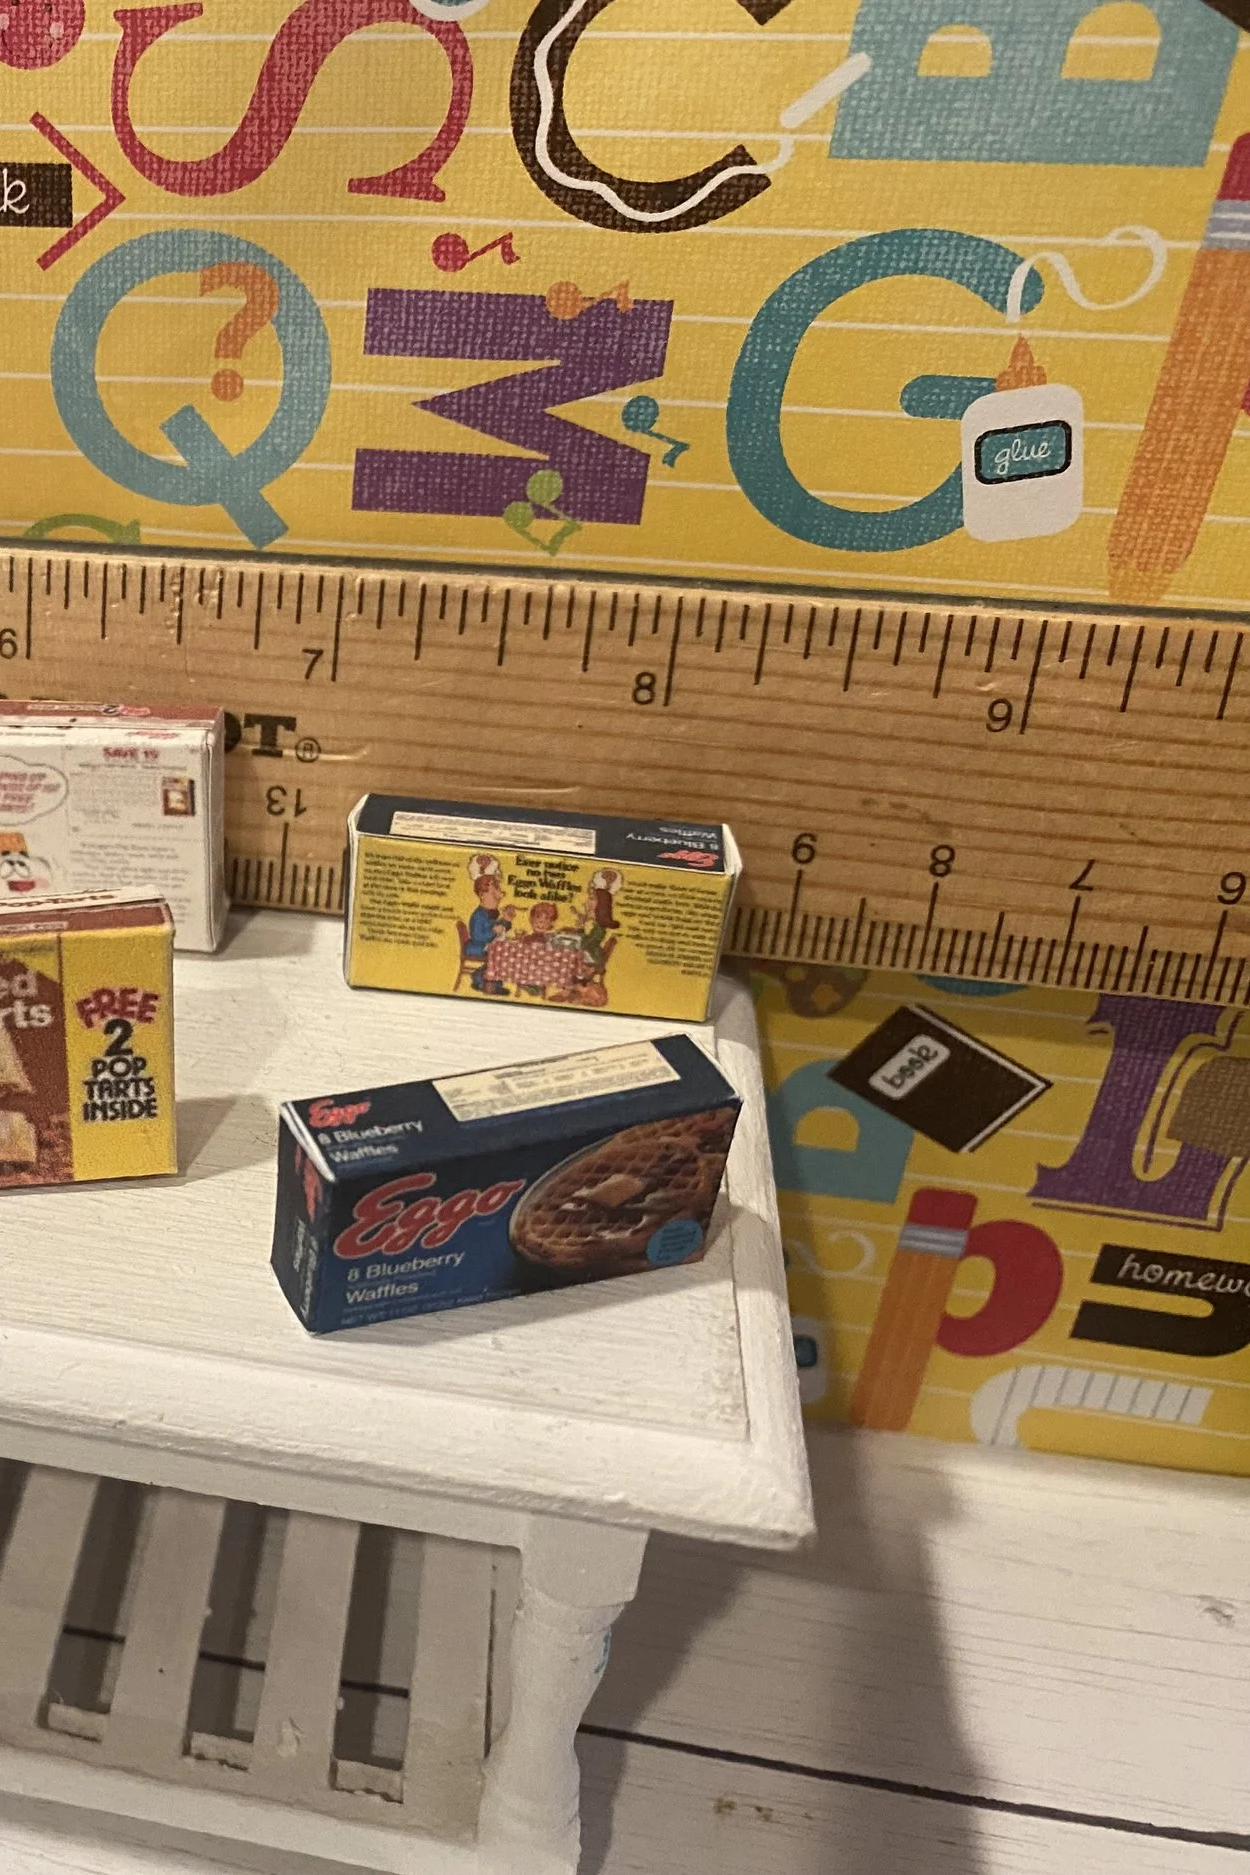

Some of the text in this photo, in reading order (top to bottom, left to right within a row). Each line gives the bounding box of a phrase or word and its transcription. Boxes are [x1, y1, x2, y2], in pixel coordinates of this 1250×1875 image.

[995, 439, 1052, 472] glue
[302, 649, 324, 680] 7
[632, 673, 657, 705] 8
[986, 699, 1013, 733] 9
[266, 786, 307, 816] 13
[929, 845, 954, 877] 8
[1069, 859, 1095, 891] 7
[75, 987, 158, 1029] FREE
[103, 1018, 133, 1057] 2
[92, 1056, 147, 1079] POP
[881, 1045, 939, 1090] book
[83, 1077, 155, 1100] TARTS
[83, 1098, 158, 1120] INSIDE
[333, 1120, 423, 1143] Blueberry
[330, 1144, 398, 1162] Waffles
[333, 1172, 527, 1259] Eggo
[347, 1251, 466, 1282] 8 Blueberry
[346, 1281, 419, 1304] Waffles
